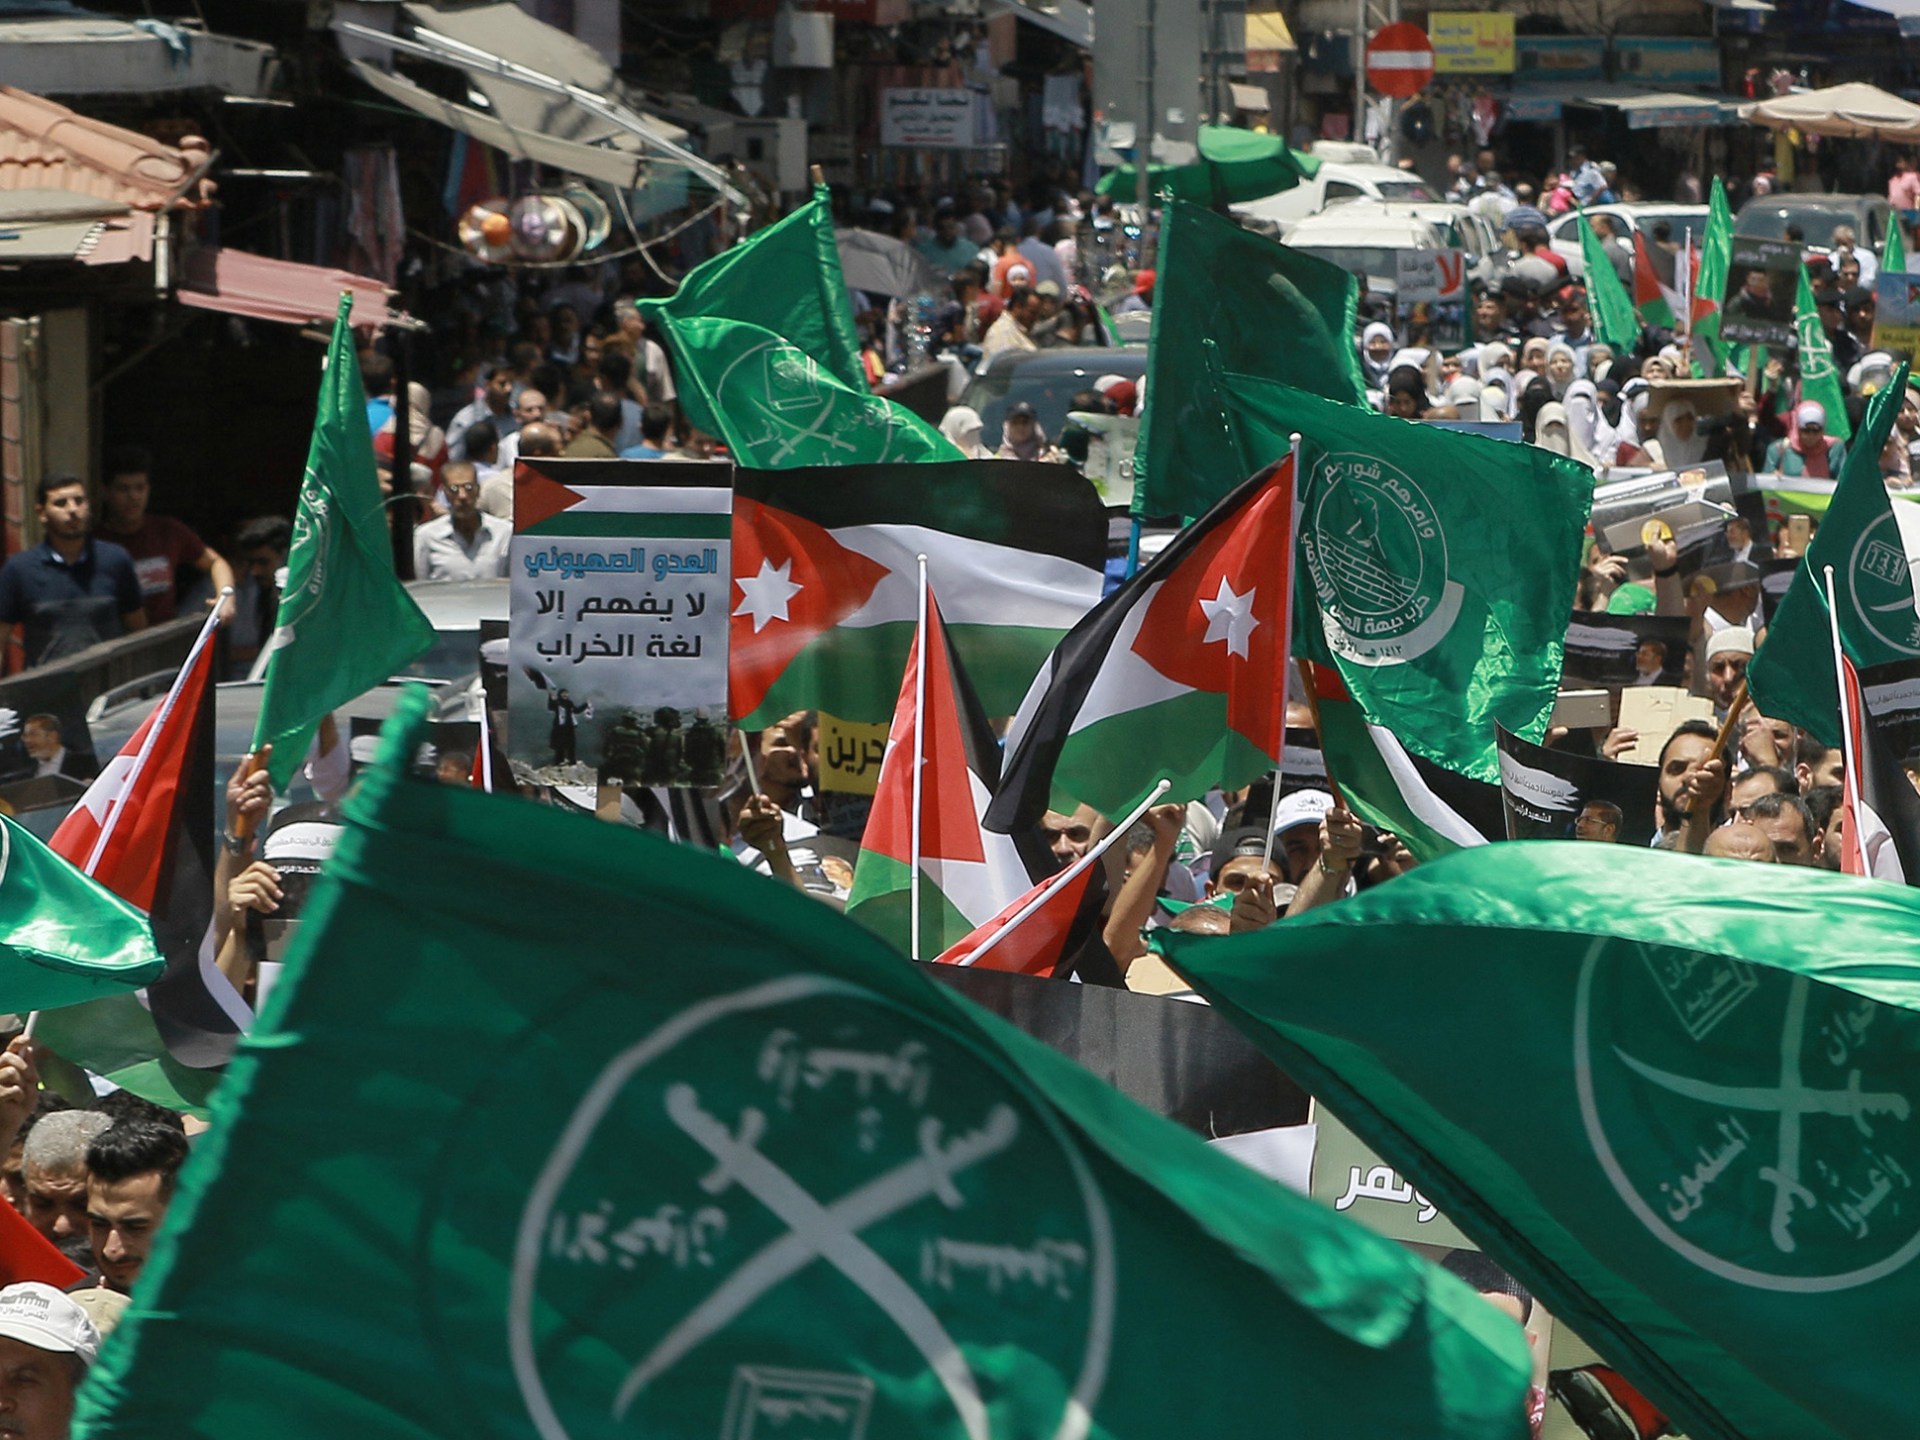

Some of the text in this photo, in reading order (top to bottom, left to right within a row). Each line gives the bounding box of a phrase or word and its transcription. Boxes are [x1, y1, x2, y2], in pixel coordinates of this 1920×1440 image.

[1435, 250, 1462, 295] لا
[523, 545, 718, 582] العدو الصهيوني
[535, 590, 706, 622] لا يفهم إلا
[1405, 593, 1431, 623] حزب
[1363, 613, 1405, 634] جبهة
[536, 632, 702, 664] لغة الخراب
[1659, 1114, 1751, 1223] المسلمون
